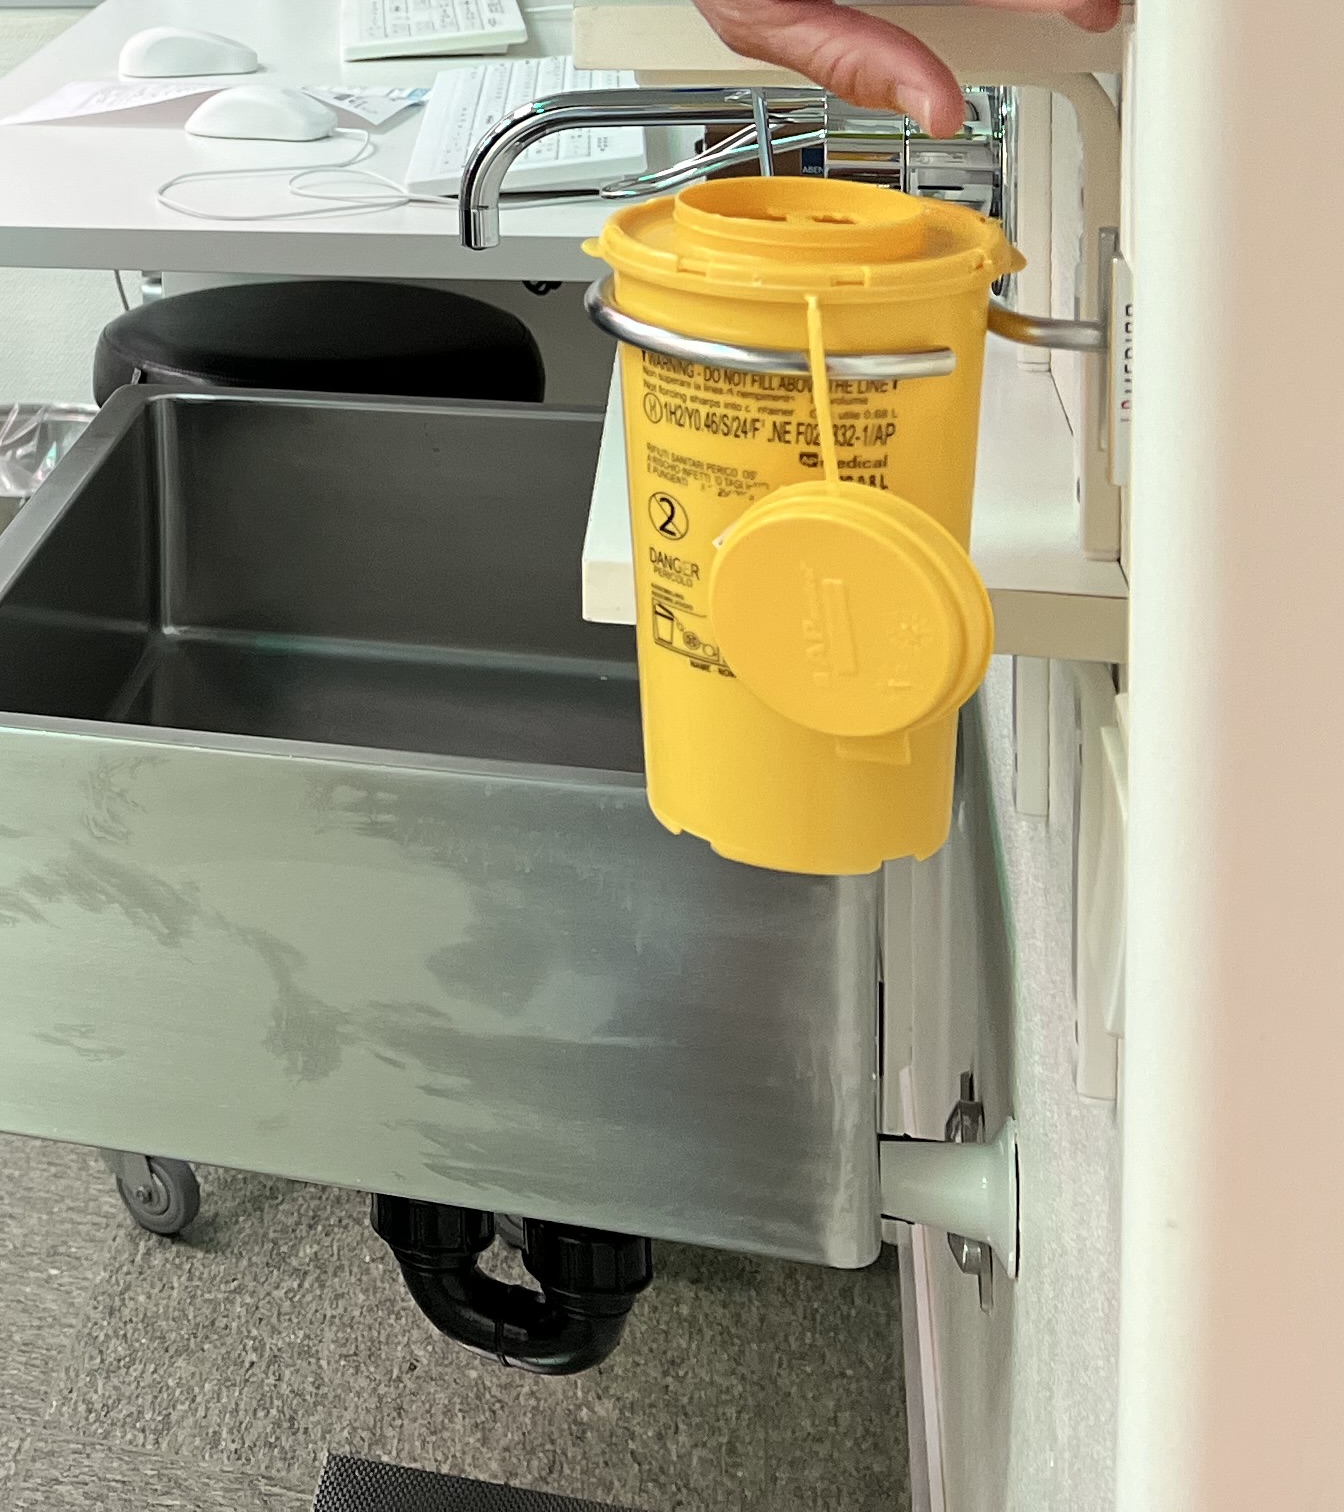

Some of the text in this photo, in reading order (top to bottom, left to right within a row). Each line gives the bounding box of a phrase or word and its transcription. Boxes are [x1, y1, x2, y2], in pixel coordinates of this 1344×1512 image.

[801, 164, 825, 175] ABEN
[703, 366, 721, 384] DO
[723, 368, 747, 388] NOT
[820, 452, 889, 469] edical
[658, 496, 678, 537] 2
[648, 546, 701, 581] DANGER
